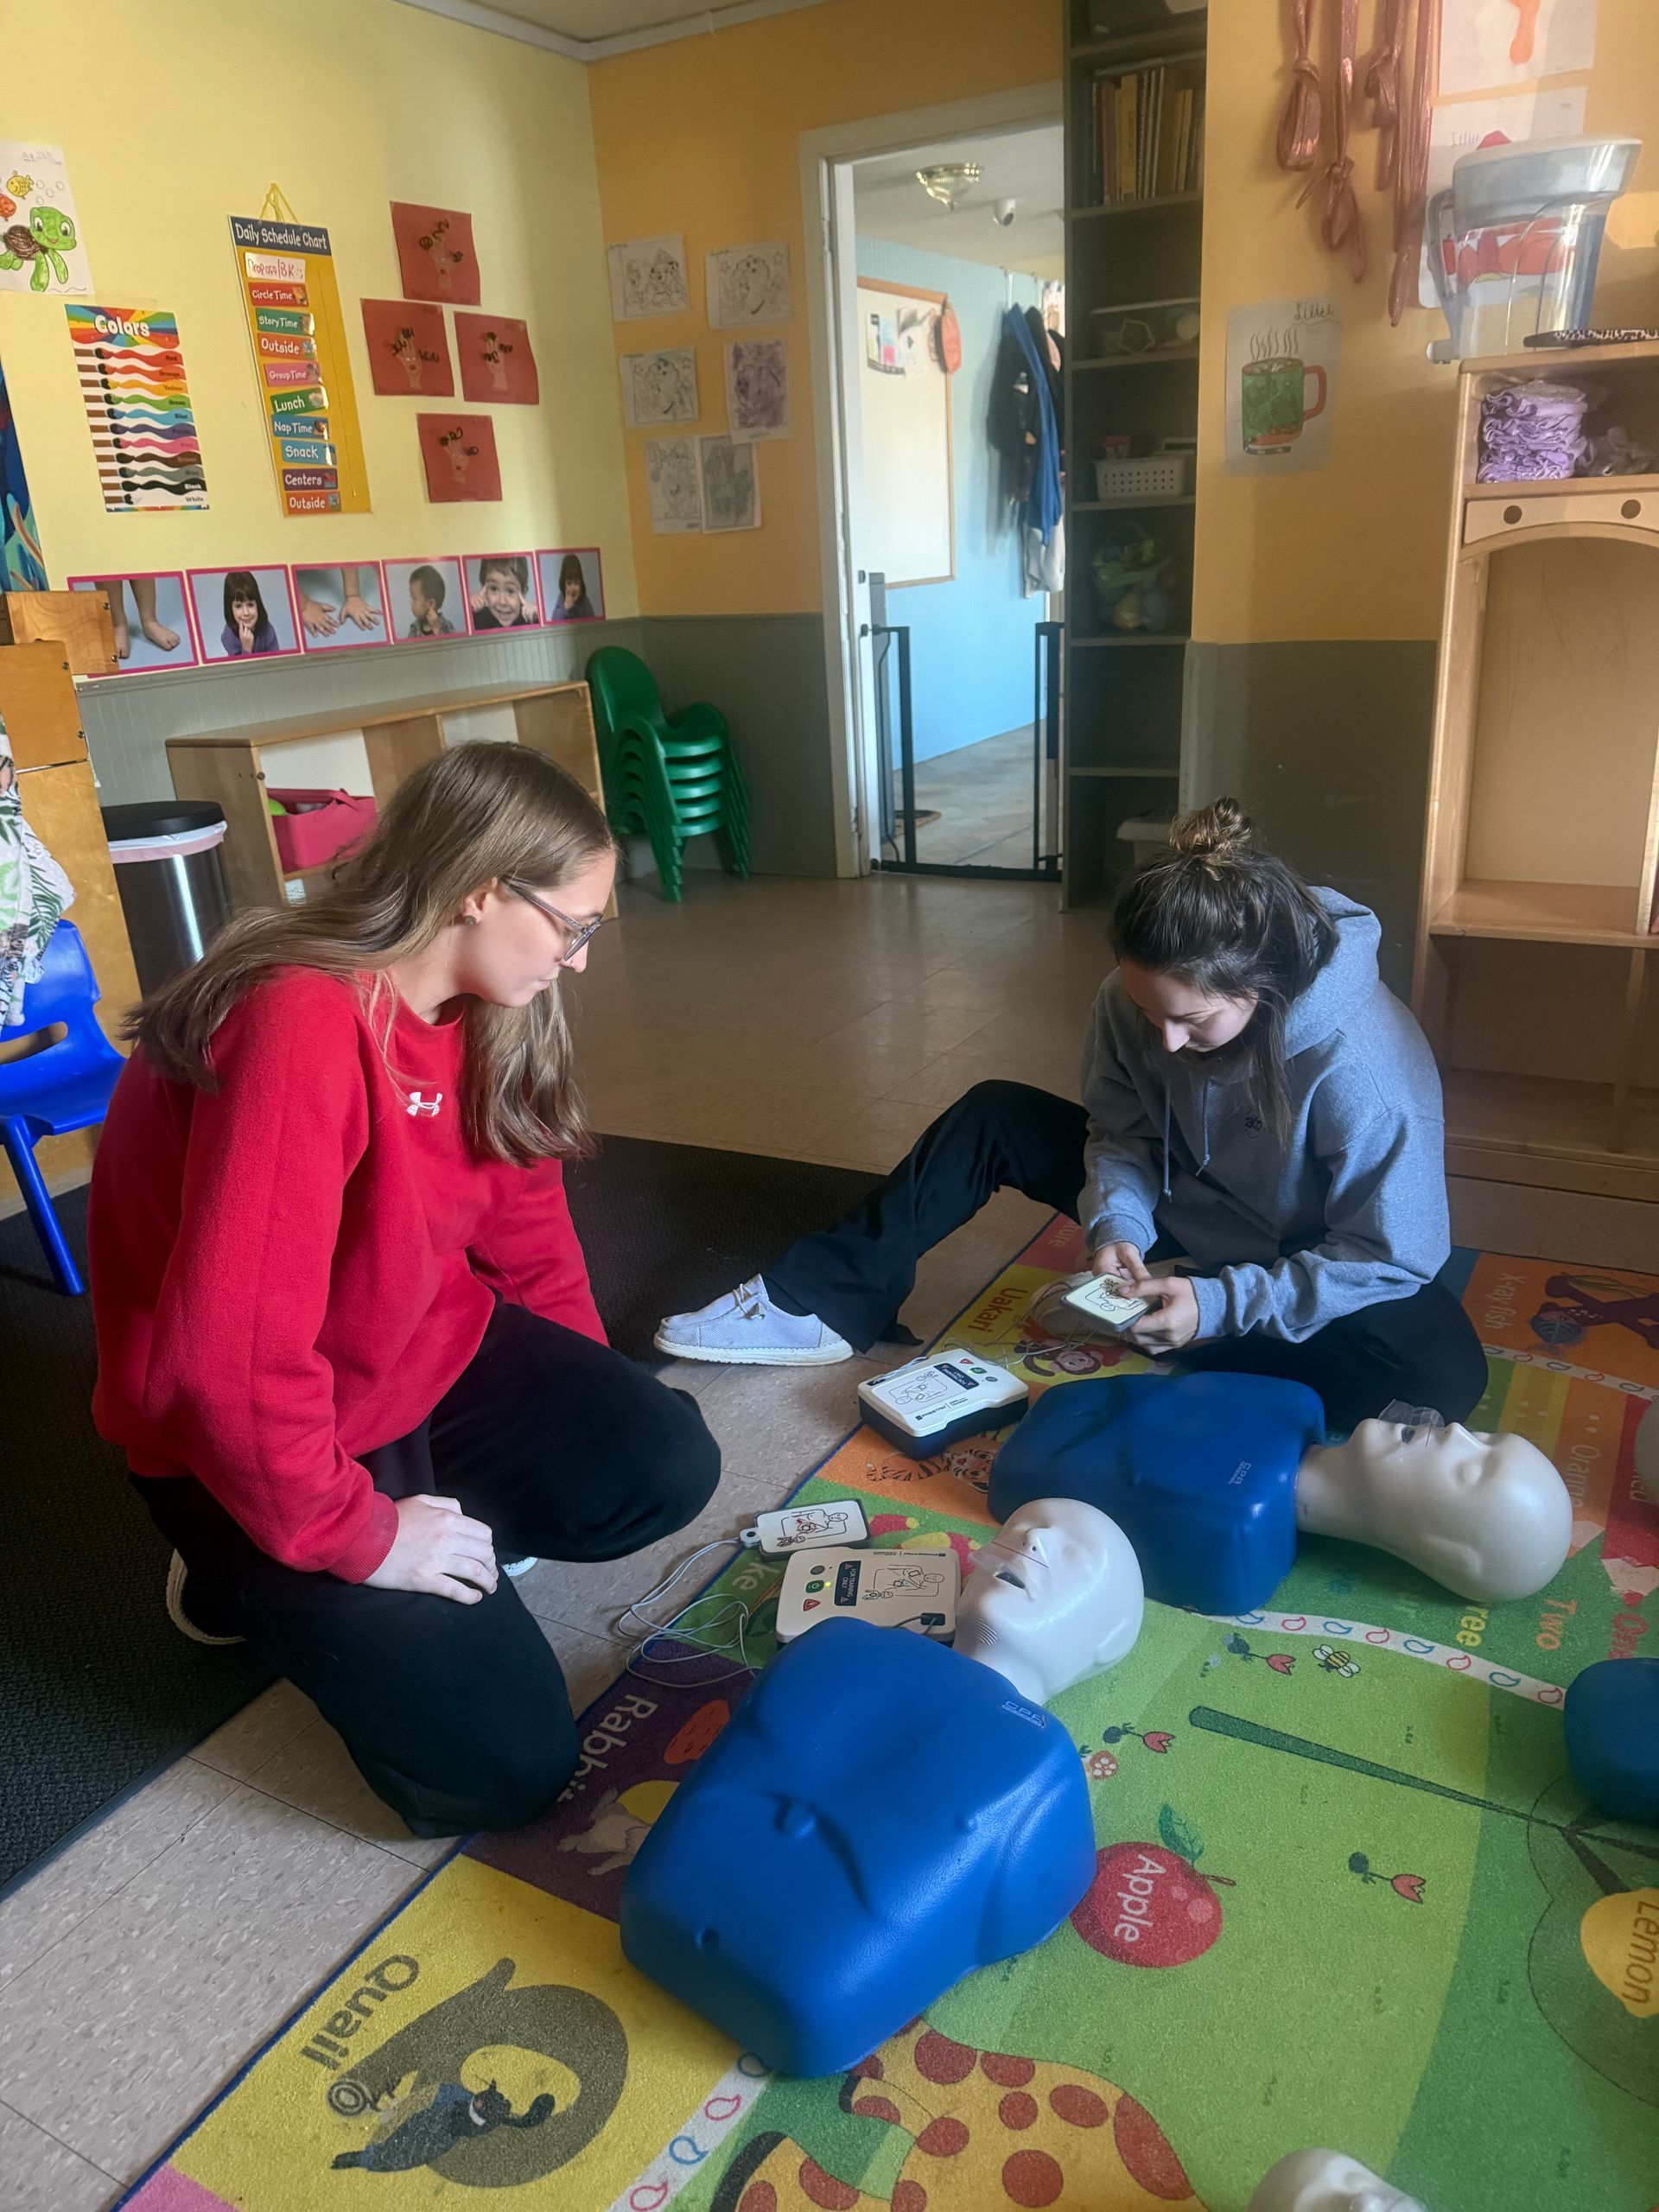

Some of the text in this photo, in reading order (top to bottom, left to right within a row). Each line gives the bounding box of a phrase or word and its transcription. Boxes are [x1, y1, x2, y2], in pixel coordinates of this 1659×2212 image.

[235, 222, 327, 250] Daily Schedule Chart
[251, 289, 293, 301] Circle Time
[94, 315, 150, 337] Colors
[259, 315, 298, 328] Story Time
[261, 338, 300, 354] Outside
[269, 370, 307, 381] Group Time
[274, 396, 305, 412] Lunch
[274, 421, 313, 435] Nap Time
[285, 445, 319, 459] Snack
[284, 474, 322, 486] Centers
[289, 498, 326, 509] Outside
[967, 1287, 1028, 1332] Uakari
[1483, 1273, 1525, 1330] X-ray fish
[841, 1577, 849, 1589] ONLY
[846, 1576, 855, 1598] TRAINING
[1455, 1605, 1490, 1648] ree
[1535, 1599, 1578, 1651] Two
[1114, 1853, 1167, 1942] Apple
[1622, 1900, 1659, 2004] Lemon
[300, 1955, 419, 2071] Quail
